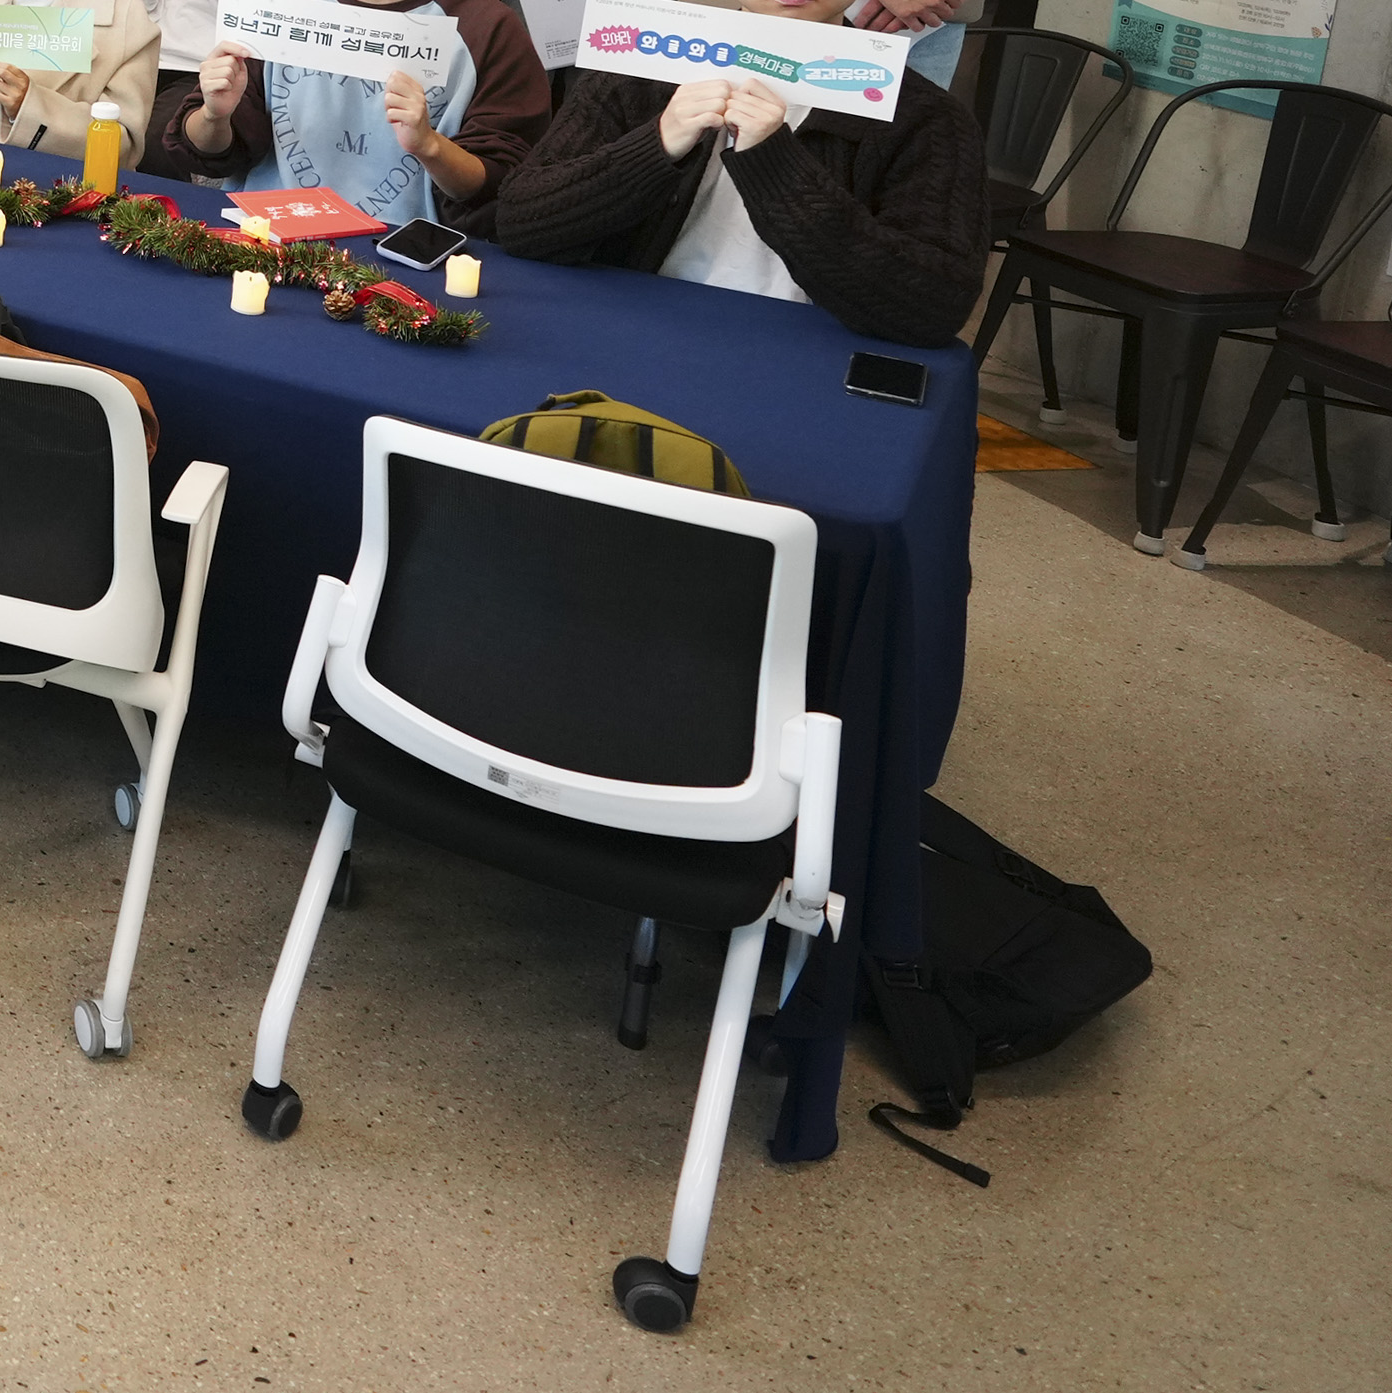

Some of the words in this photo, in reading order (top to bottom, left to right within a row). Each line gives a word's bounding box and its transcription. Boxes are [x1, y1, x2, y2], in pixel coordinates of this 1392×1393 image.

[27, 34, 47, 50] 결과
[49, 35, 82, 53] 공유회
[222, 12, 282, 37] 청년과
[289, 27, 333, 47] 함께
[340, 36, 439, 62] 성북에서!
[253, 8, 317, 27] 서울청년센터
[318, 21, 341, 32] 성북
[344, 25, 367, 36] 결과
[369, 28, 404, 41] 공유회
[601, 31, 632, 48] 모여라
[640, 34, 729, 63] 와글와글
[738, 48, 795, 77] 성북마을
[803, 64, 886, 82] 결과공유회
